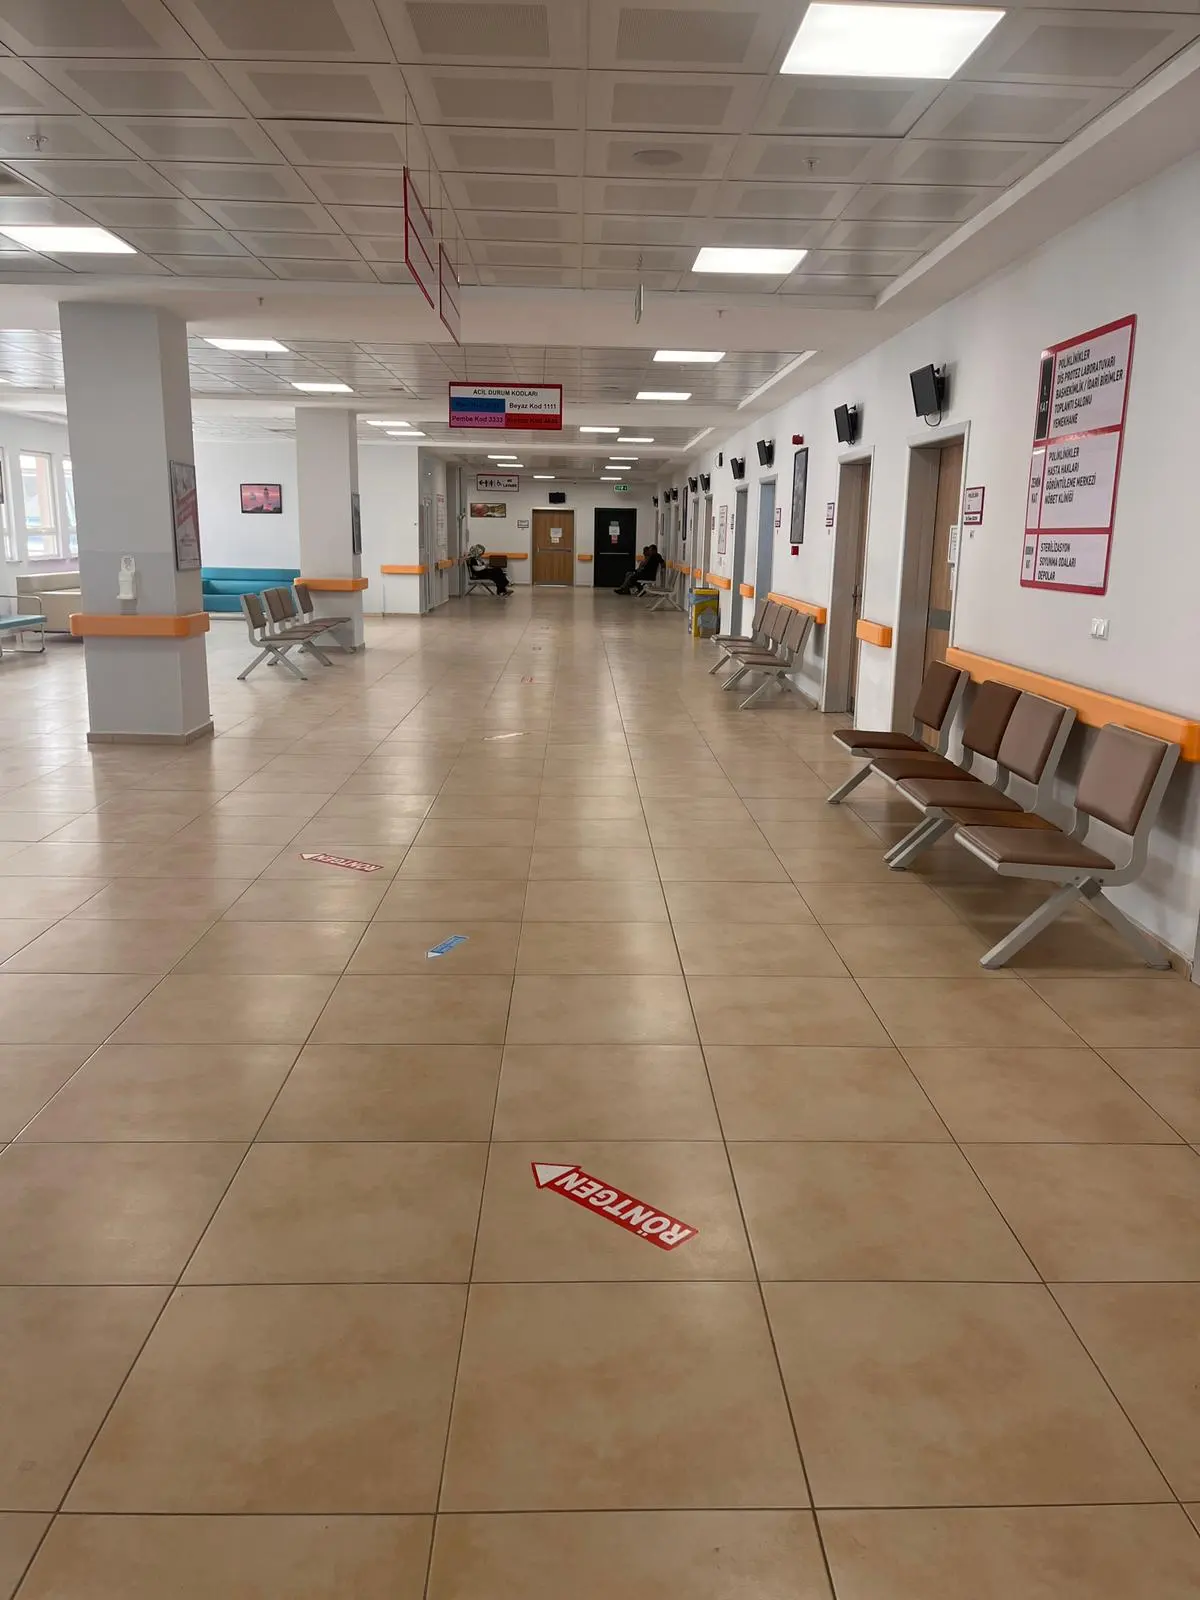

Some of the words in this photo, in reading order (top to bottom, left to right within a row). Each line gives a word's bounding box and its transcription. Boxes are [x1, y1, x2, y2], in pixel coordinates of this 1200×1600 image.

[1059, 349, 1090, 370] POLİKLİNİKLER
[1064, 368, 1080, 382] PROTEZ
[1081, 355, 1116, 376] LABORATUVARI
[510, 402, 528, 411] Beyaz
[1055, 399, 1074, 414] TOPLANTI
[1074, 394, 1092, 408] SALONU
[1048, 446, 1079, 461] POLİKLİNİKLER
[1048, 465, 1060, 476] HASTA
[1061, 462, 1079, 473] HAKLARI
[1046, 476, 1076, 490] GÖRÜNTÜLEME
[1076, 472, 1096, 486] MERKEZİ
[1044, 493, 1058, 504] NÖBET
[1040, 540, 1070, 552] STERİLİZASYON
[1040, 556, 1057, 567] SOYUNMA
[1059, 557, 1076, 568] ODALARI
[1037, 568, 1056, 580] DEPOLAR
[554, 1172, 692, 1246] RÖNTGEN
